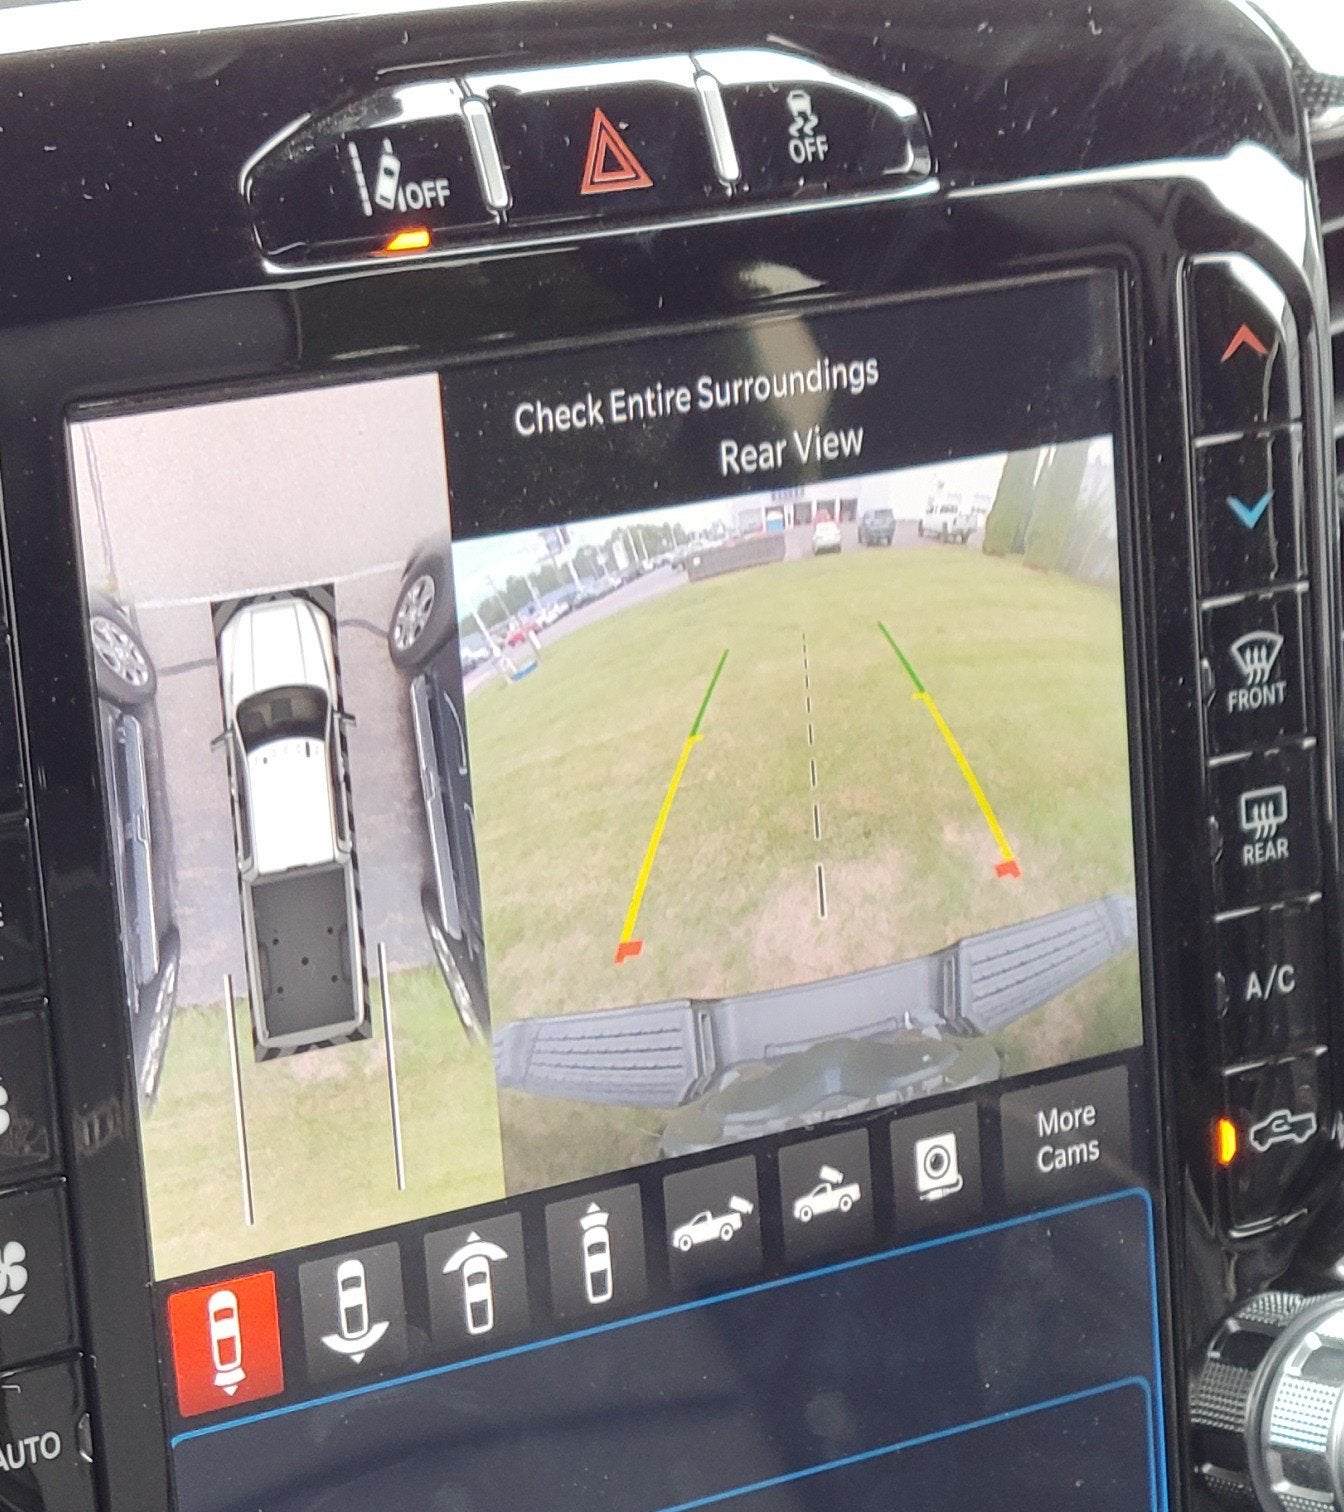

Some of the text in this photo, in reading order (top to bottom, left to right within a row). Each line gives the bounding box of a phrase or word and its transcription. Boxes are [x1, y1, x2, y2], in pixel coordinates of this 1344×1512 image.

[788, 137, 829, 164] OFF
[406, 180, 450, 210] OFF
[514, 356, 880, 436] Check Entire Surroundings
[720, 424, 864, 476] Rear View
[1227, 681, 1287, 712] FRONT
[1242, 839, 1289, 867] REAR
[1245, 965, 1297, 1002] A/C
[1037, 1104, 1097, 1138] More
[1037, 1138, 1100, 1173] Cams
